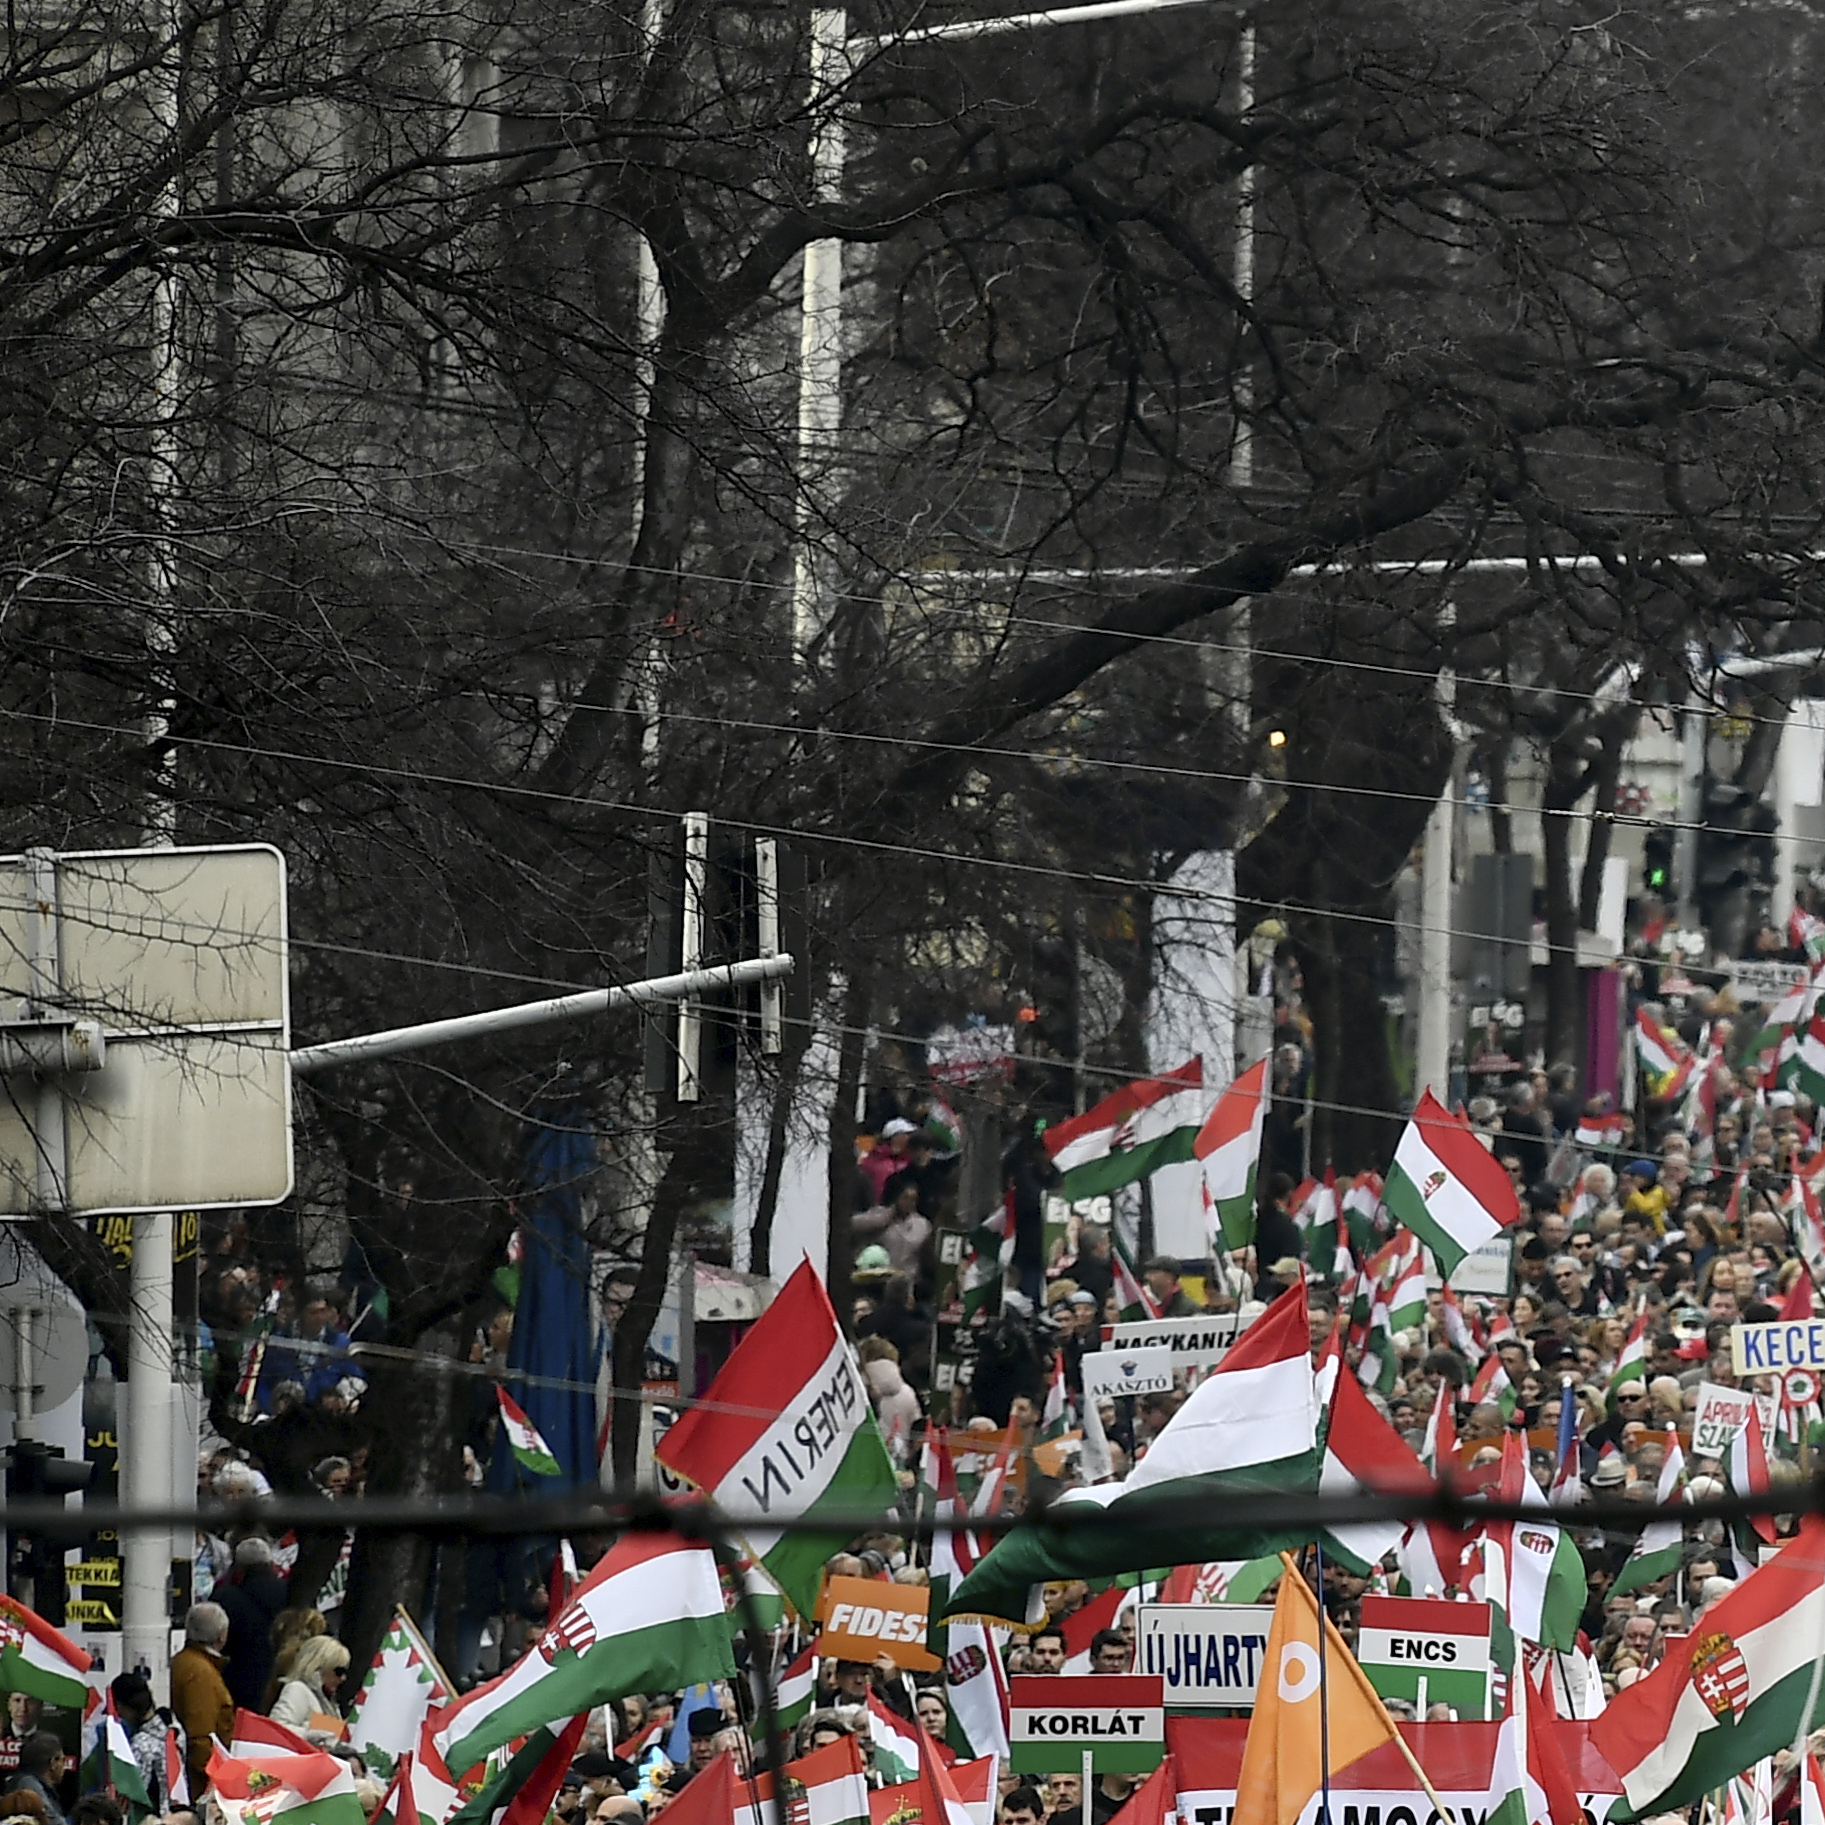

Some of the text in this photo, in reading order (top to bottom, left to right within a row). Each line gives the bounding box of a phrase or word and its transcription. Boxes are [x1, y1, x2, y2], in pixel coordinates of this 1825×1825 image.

[1092, 1375, 1168, 1396] AKASZTÓ
[1389, 1638, 1457, 1662] ENCS
[1027, 1708, 1146, 1738] KORLÁT
